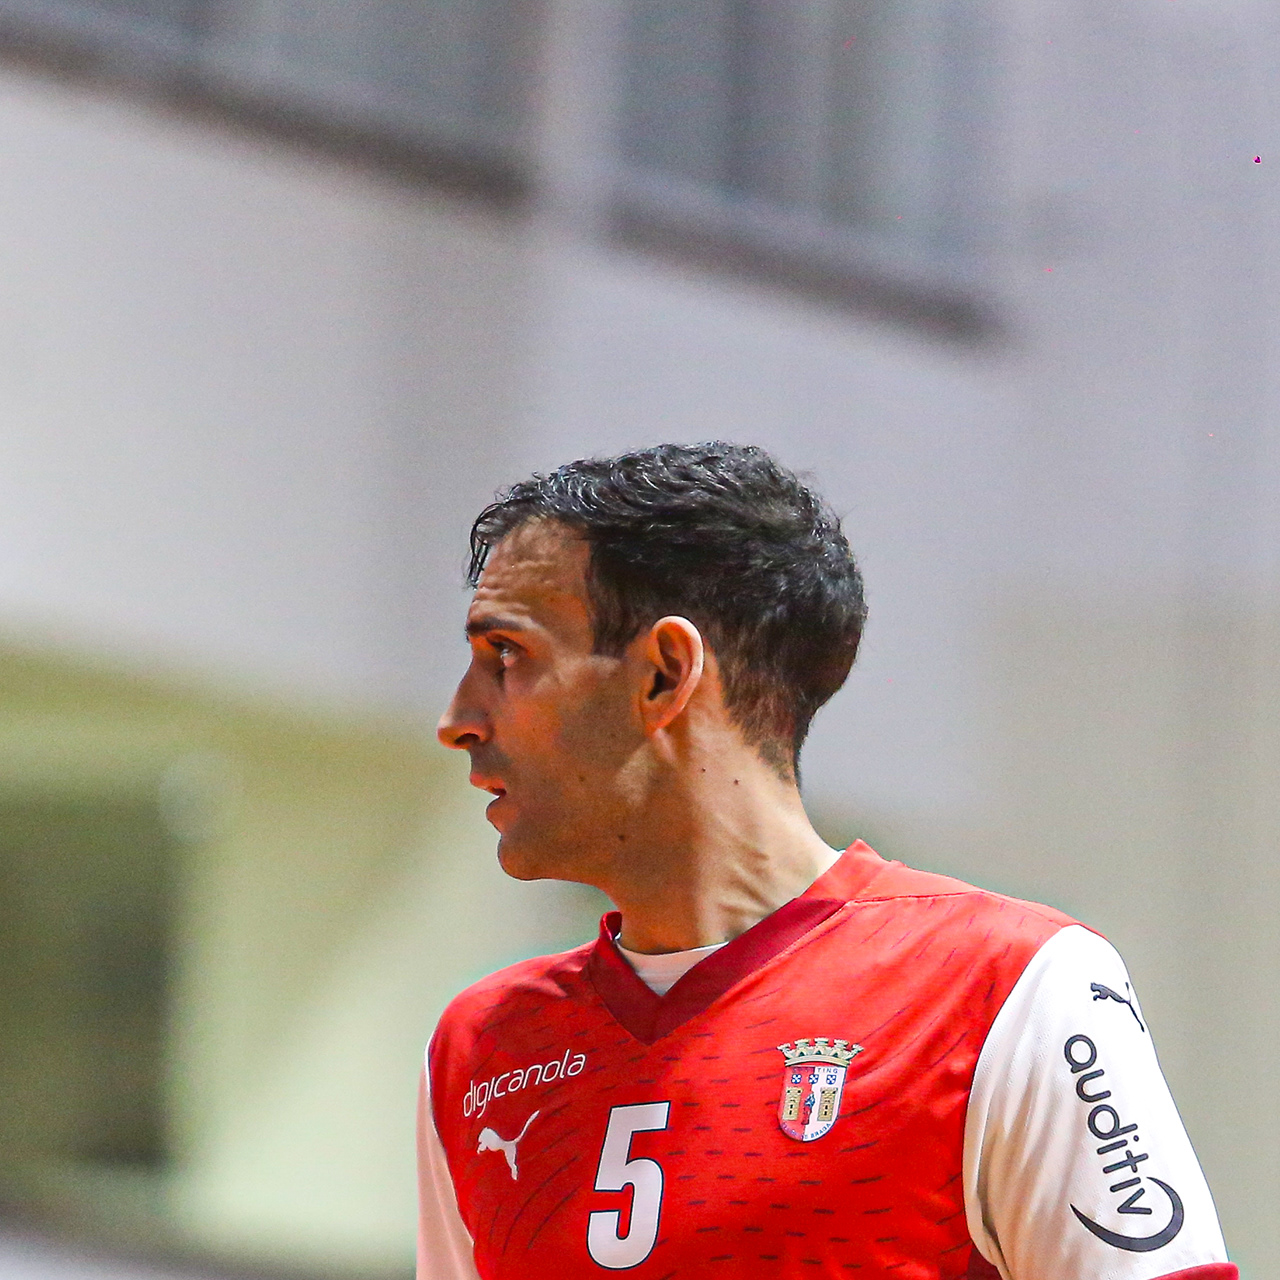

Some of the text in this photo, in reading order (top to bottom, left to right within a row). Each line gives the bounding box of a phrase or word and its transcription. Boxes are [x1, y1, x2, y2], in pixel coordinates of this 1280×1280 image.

[463, 1048, 586, 1119] digicanola
[1064, 1034, 1152, 1216] auditiv
[587, 1101, 671, 1270] 5
